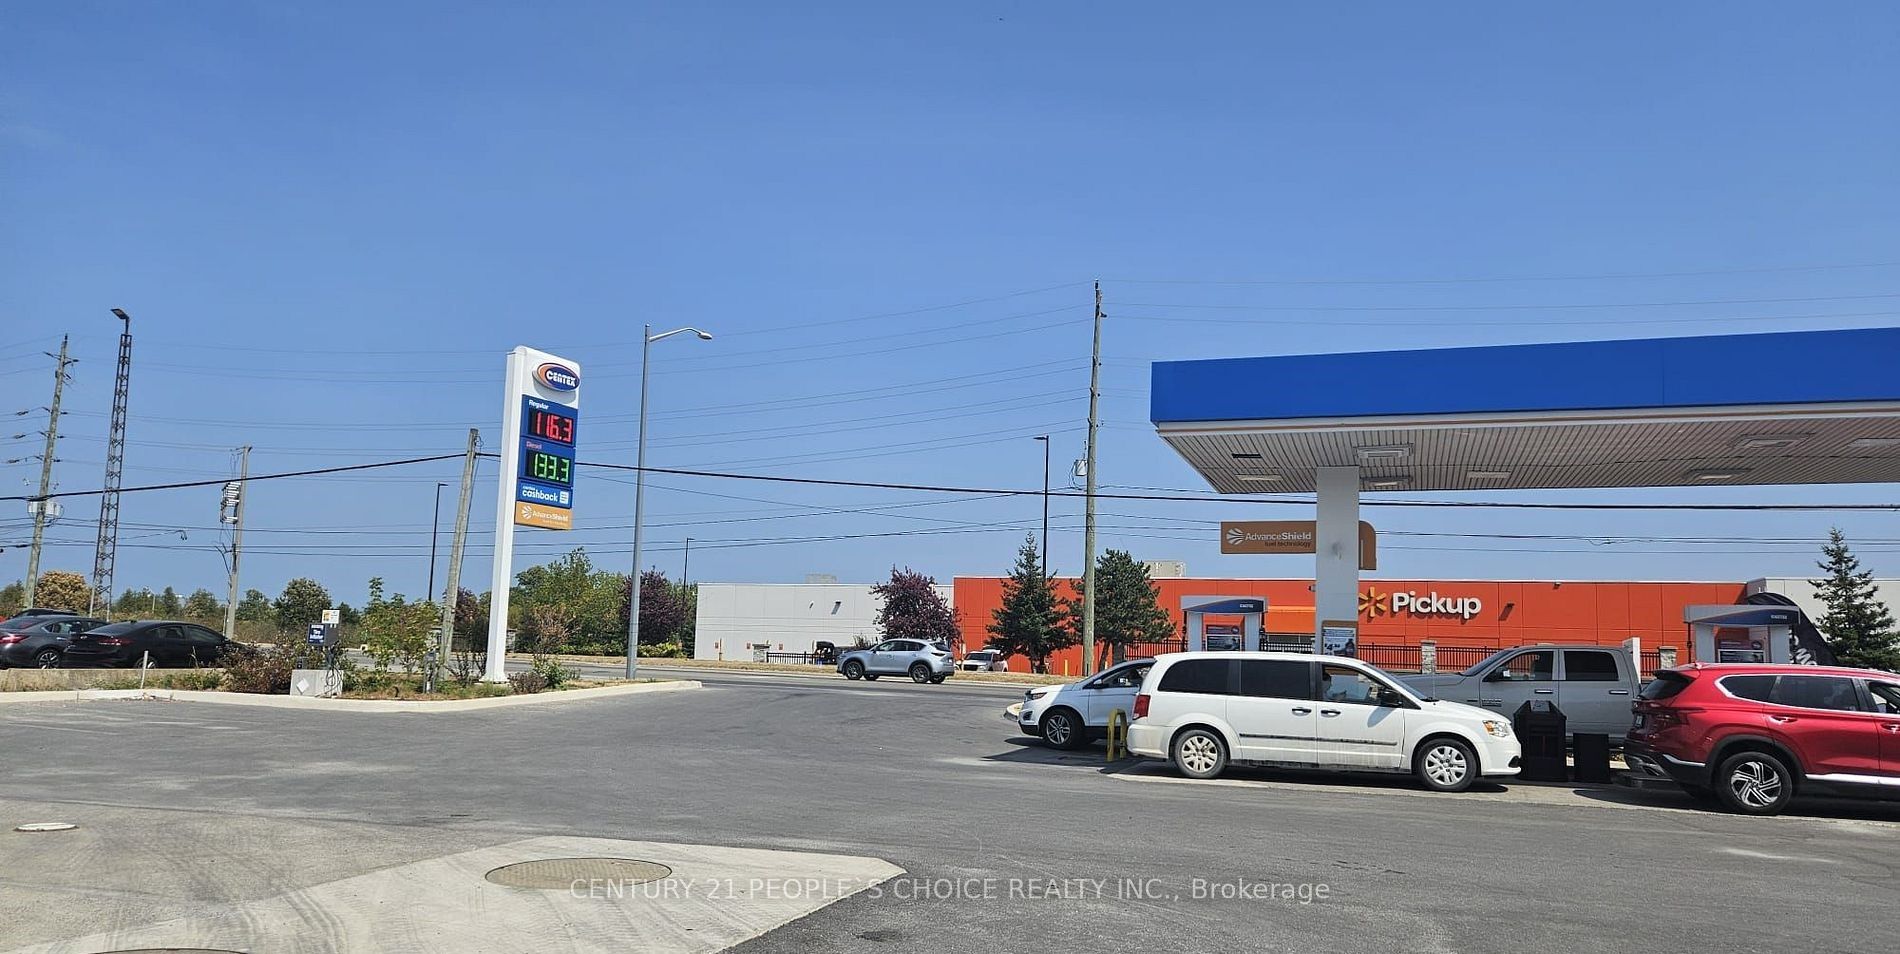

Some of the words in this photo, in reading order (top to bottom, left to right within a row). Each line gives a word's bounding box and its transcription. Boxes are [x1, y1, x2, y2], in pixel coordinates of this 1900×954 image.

[546, 370, 576, 387] CENTEX
[528, 400, 549, 410] Regular
[536, 411, 573, 443] 116.3
[534, 453, 570, 483] 133.3
[522, 488, 558, 502] cashback
[1245, 532, 1312, 541] AdvanceShield
[1393, 590, 1482, 619] Pickup
